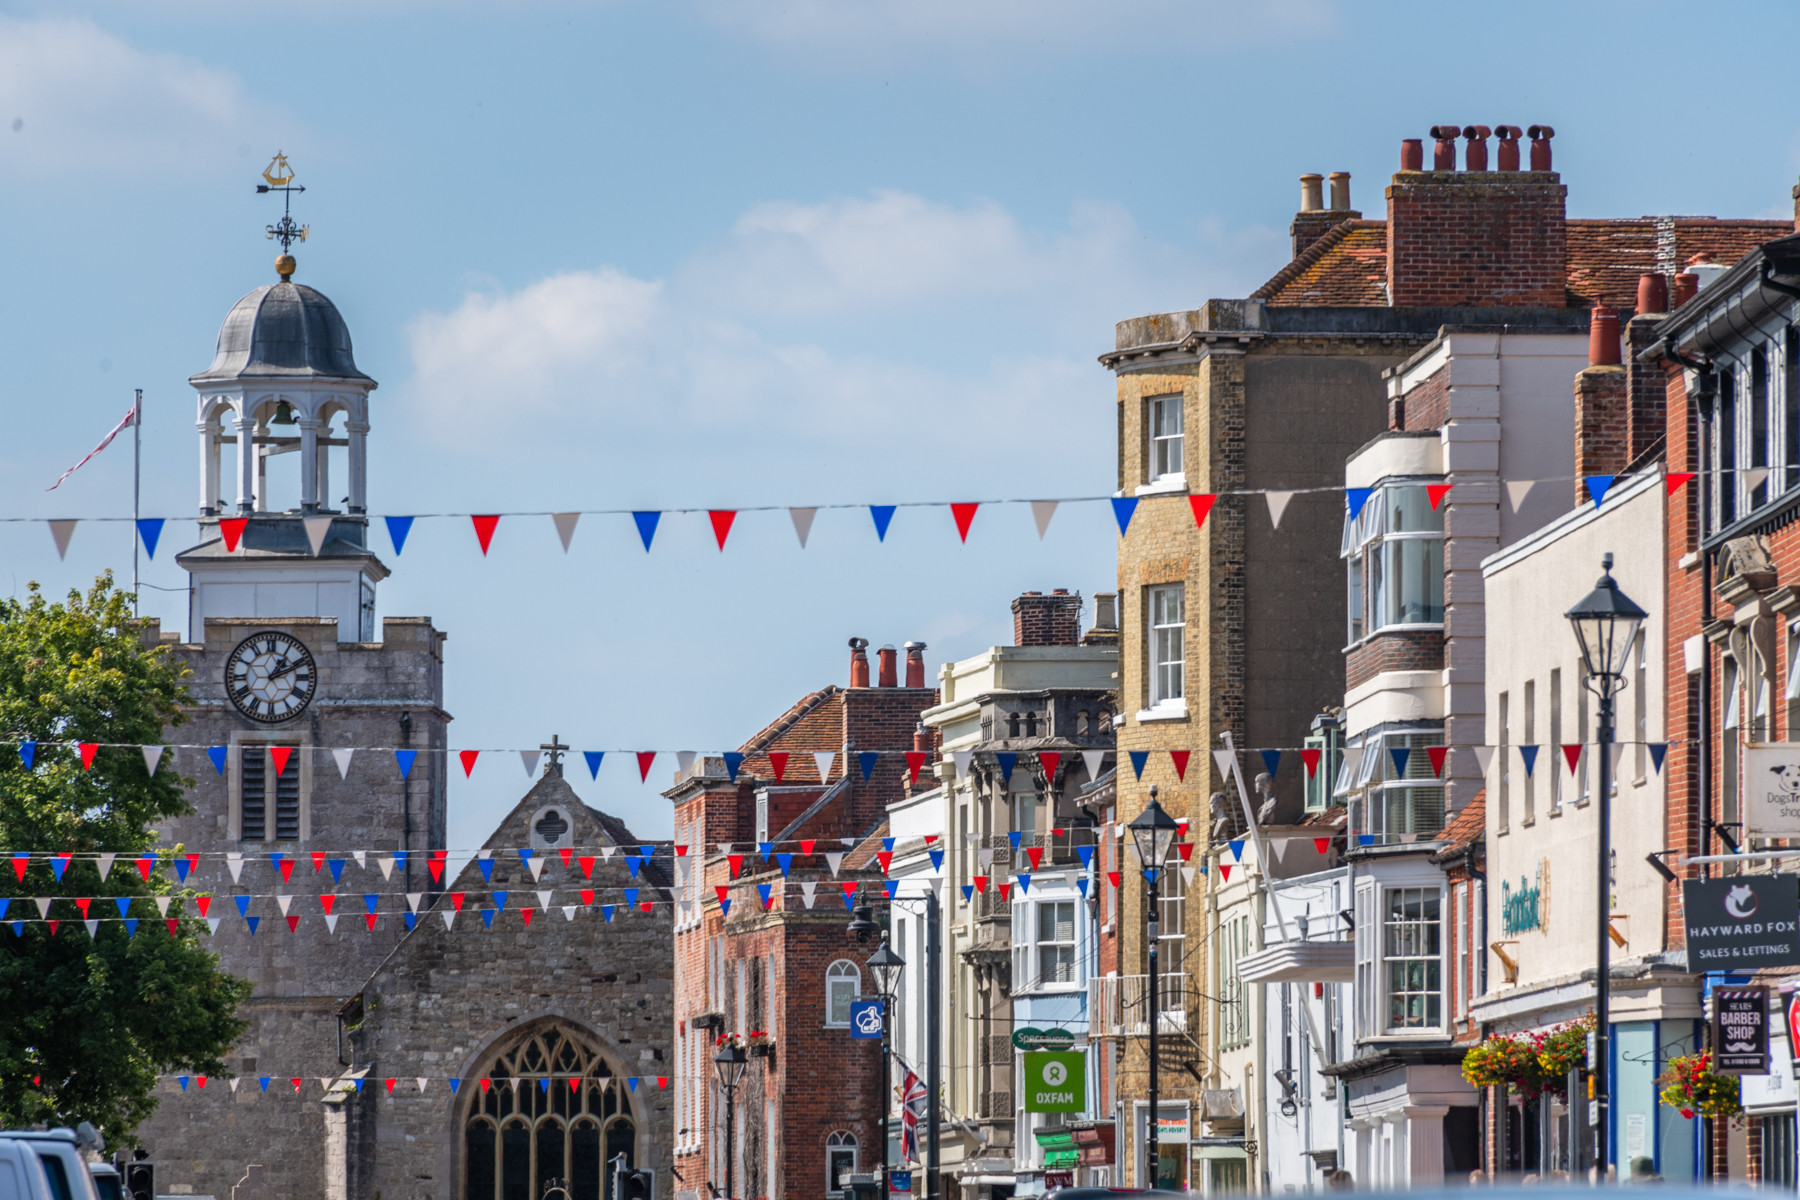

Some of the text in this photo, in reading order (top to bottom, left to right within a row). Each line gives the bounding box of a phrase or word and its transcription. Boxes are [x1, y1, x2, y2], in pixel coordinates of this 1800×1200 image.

[1690, 921, 1795, 937] HAYWARD FOX
[1699, 944, 1790, 959] SALES & LETTINGS
[1729, 1002, 1752, 1011] SEARS
[1720, 1011, 1761, 1025] BARBER
[1727, 1026, 1756, 1040] SHOP
[1036, 1092, 1074, 1104] OXFAM
[1046, 1176, 1073, 1186] EWM
